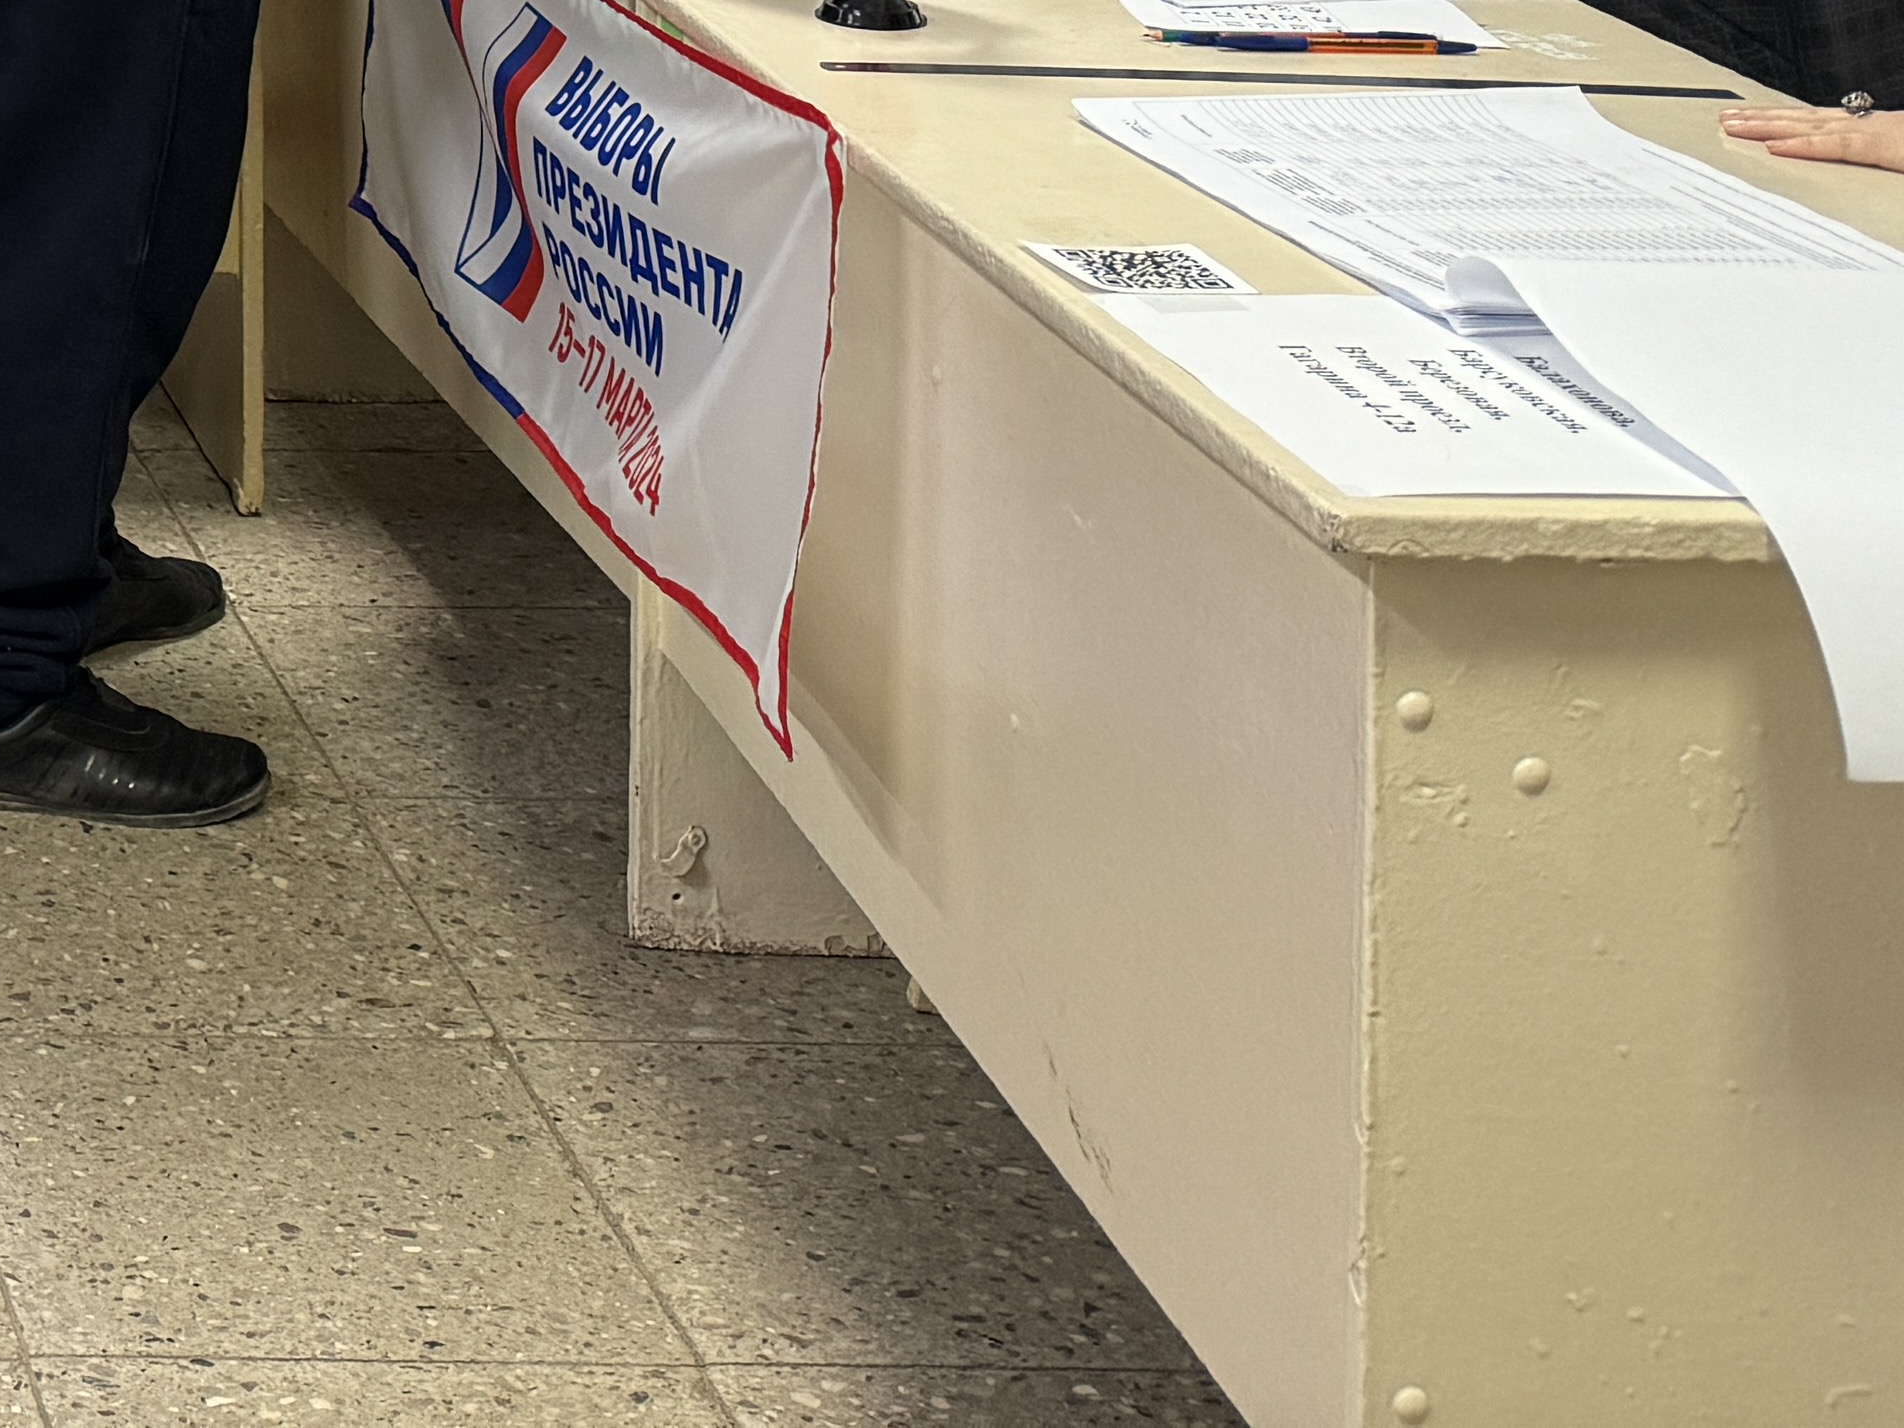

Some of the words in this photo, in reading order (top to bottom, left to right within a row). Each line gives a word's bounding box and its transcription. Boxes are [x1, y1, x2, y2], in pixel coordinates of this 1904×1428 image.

[544, 55, 676, 206] ВЫБОРЫ
[532, 135, 743, 344] ПРЕЗИДЕНТА
[542, 221, 664, 378] РОССИИ
[596, 356, 655, 463] МАРТА
[622, 425, 664, 517] 2024
